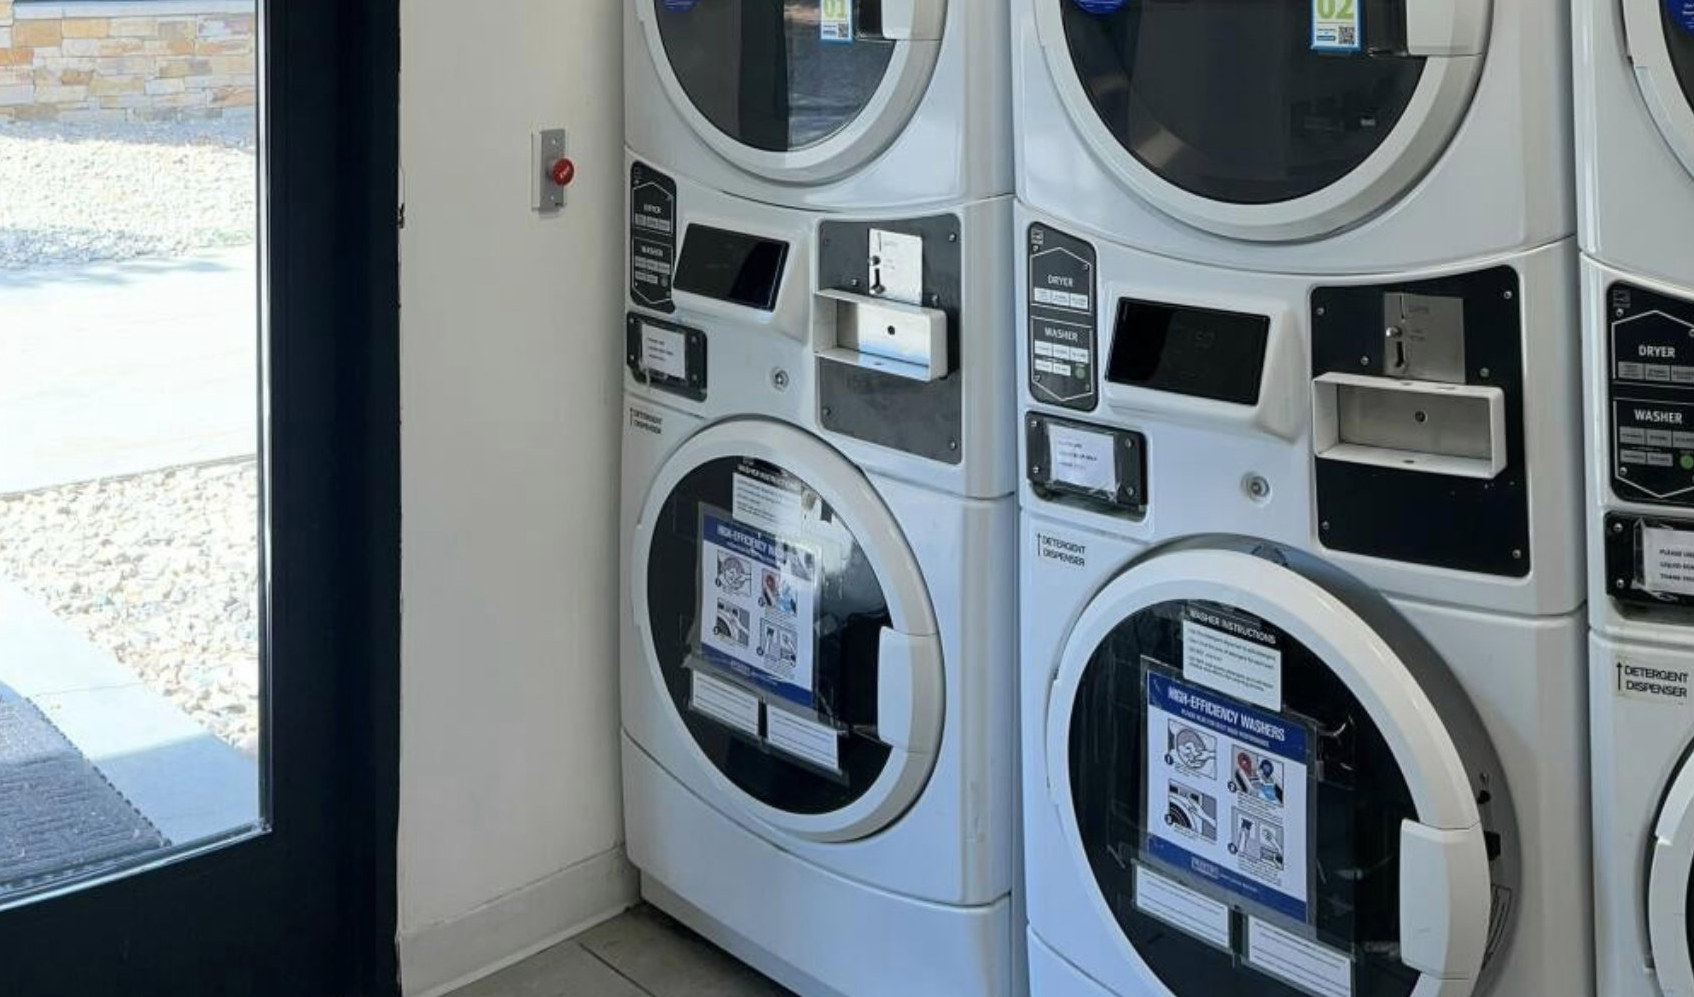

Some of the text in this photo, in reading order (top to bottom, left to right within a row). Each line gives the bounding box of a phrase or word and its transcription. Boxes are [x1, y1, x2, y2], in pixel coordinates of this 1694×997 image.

[1047, 274, 1074, 288] DRYER
[1044, 327, 1079, 343] WASHER
[1638, 344, 1676, 358] DRYER
[1633, 408, 1682, 424] WASHER
[1042, 535, 1086, 553] DETERGENT
[1042, 549, 1085, 567] DISPENSER
[1189, 609, 1277, 645] WASHER INSTRUCTIONS
[1624, 665, 1689, 683] DETERGENT
[1626, 680, 1687, 698] DISPENSER
[1167, 686, 1239, 725] HIGH-EFFICIENCY
[1240, 712, 1286, 742] WASHERS
